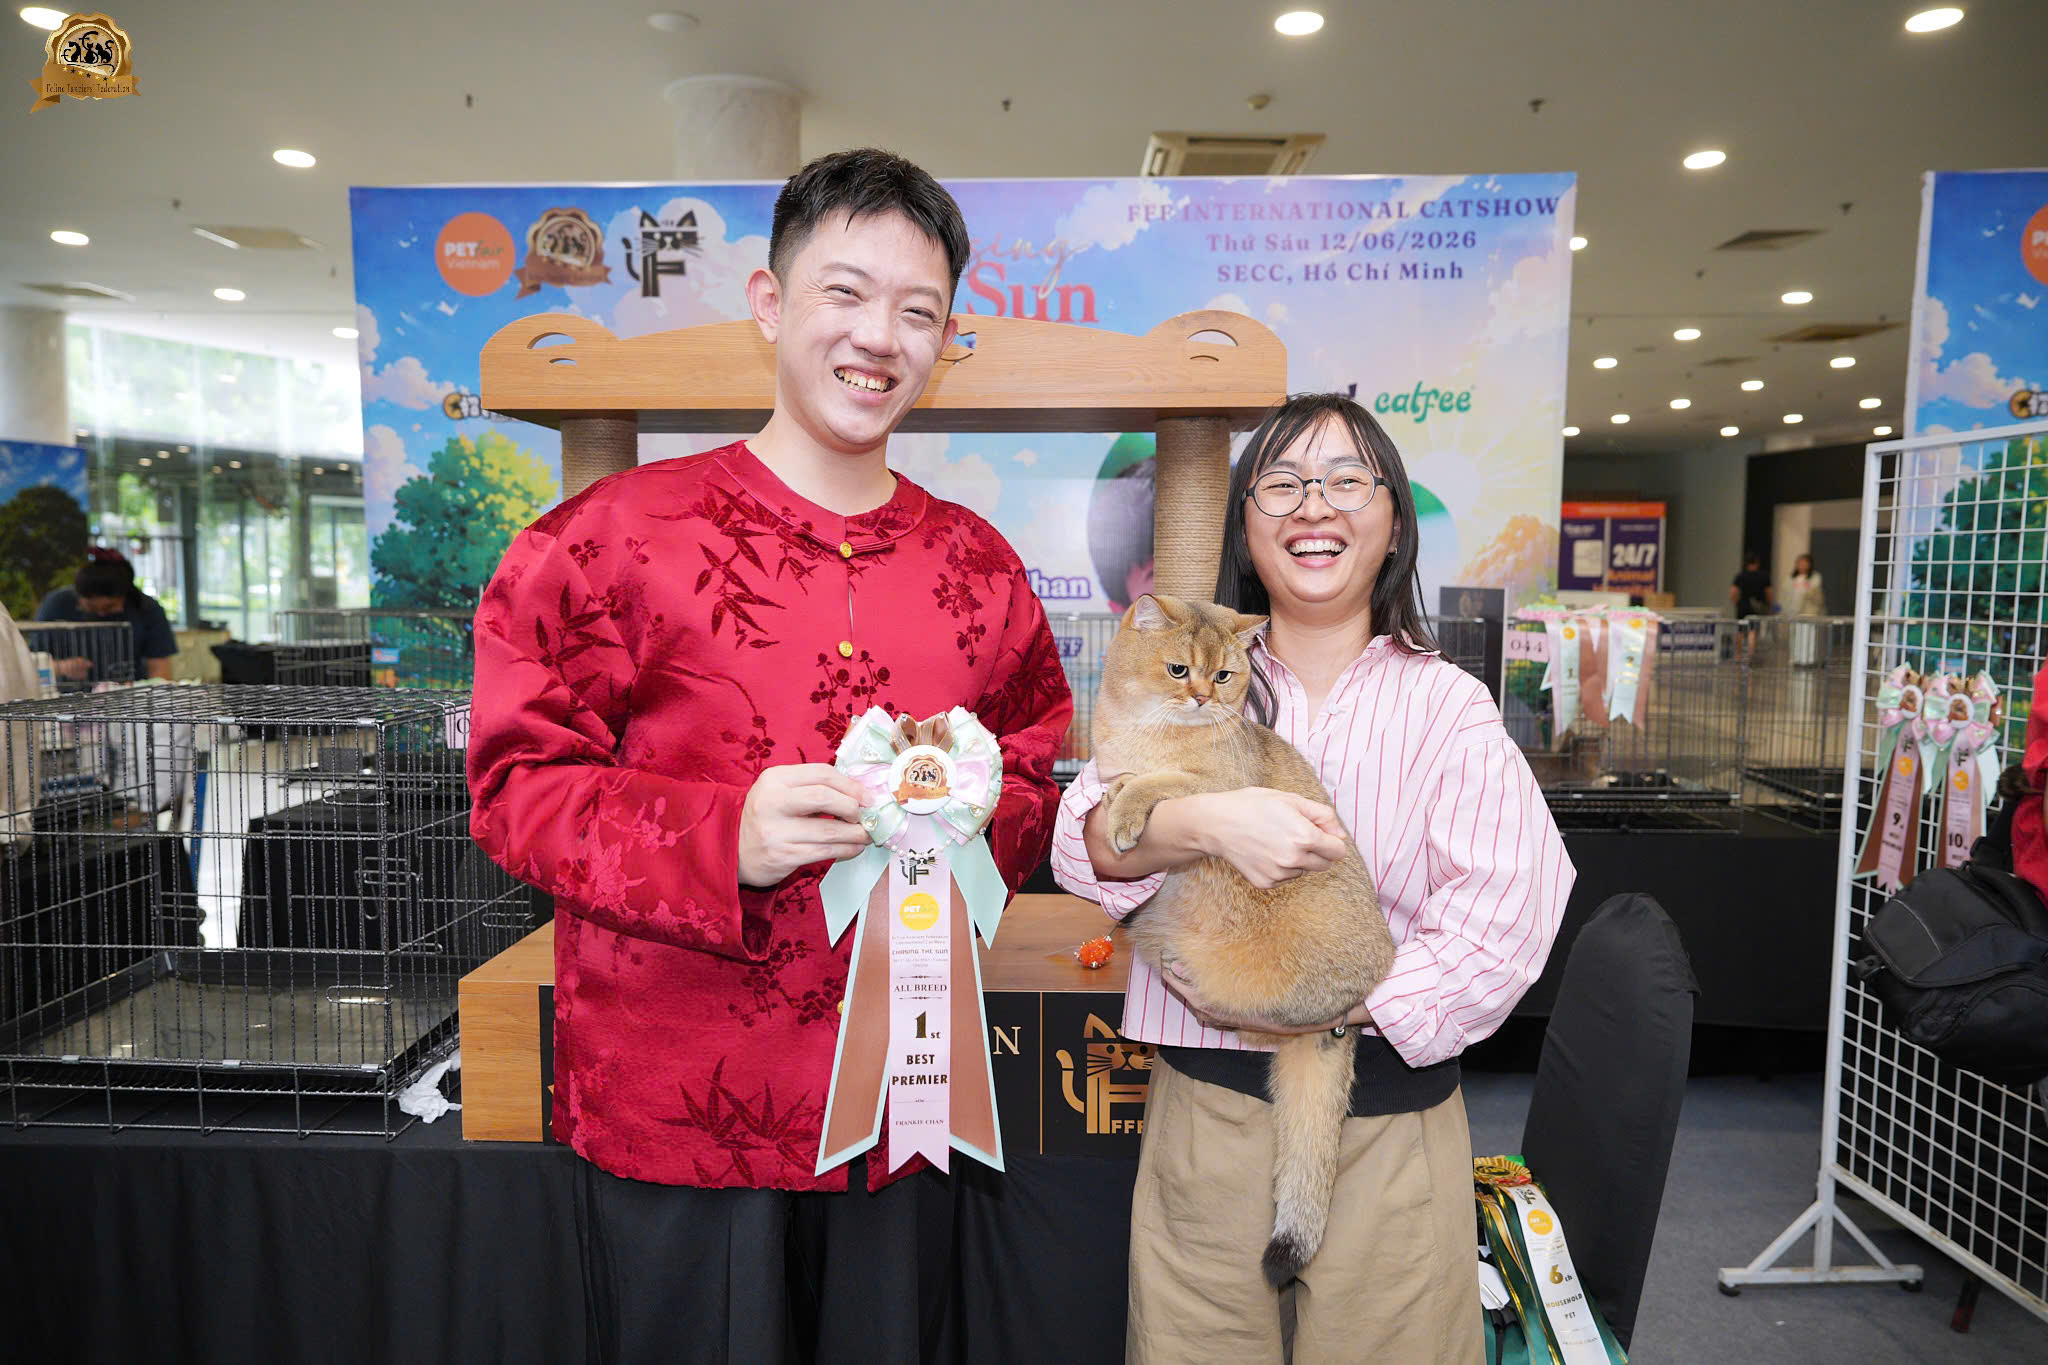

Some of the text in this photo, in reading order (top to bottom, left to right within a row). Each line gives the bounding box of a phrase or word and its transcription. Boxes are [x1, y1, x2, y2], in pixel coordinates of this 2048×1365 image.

[1127, 197, 1561, 222] FFF INTERNATIONAL CATSHOW
[443, 240, 478, 257] PET
[1206, 230, 1477, 253] Thứ Sáu 12/06/2026
[1216, 259, 1464, 285] SECC, Hồ Chí Minh
[966, 262, 1099, 323] Sun
[1612, 543, 1658, 568] 24/7
[1026, 568, 1091, 600] han
[1948, 832, 1968, 850] 10
[893, 983, 948, 993] ALL BREED
[915, 1010, 941, 1039] 1st
[906, 1053, 936, 1066] BEST
[891, 1073, 949, 1086] PREMIER
[1545, 1292, 1583, 1309] HOUSEHOLD
[1564, 1311, 1577, 1320] PET
